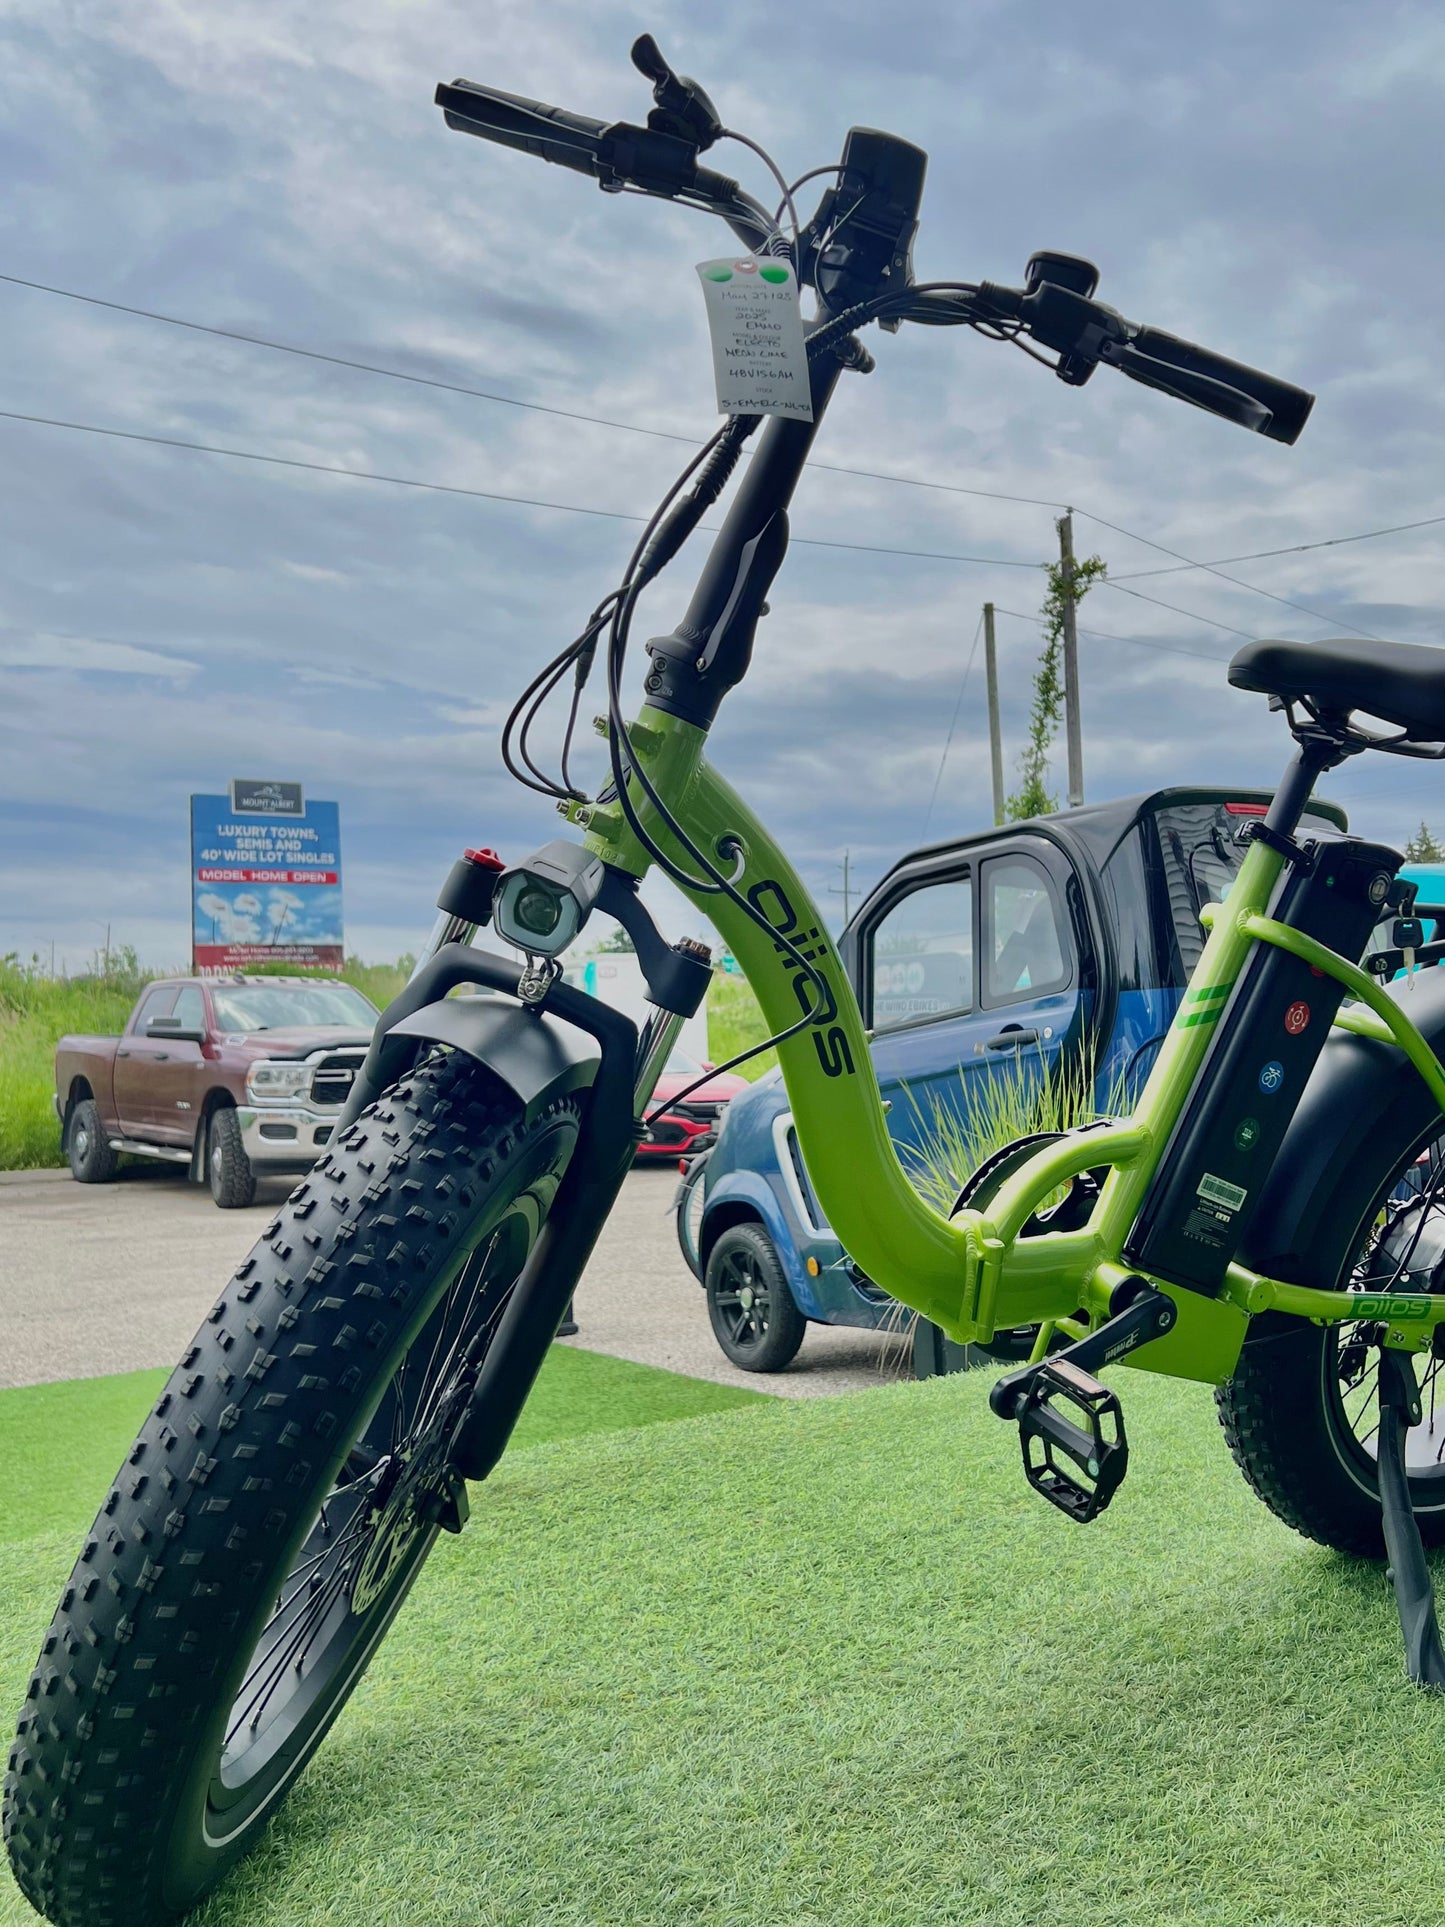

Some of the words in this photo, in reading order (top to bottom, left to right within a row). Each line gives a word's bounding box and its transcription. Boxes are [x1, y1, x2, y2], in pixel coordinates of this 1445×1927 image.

[735, 312, 767, 321] 2025
[242, 797, 270, 807] MOUNT
[217, 825, 267, 837] LUXURY
[270, 827, 319, 841] TOWNS,
[236, 837, 273, 849] SEMIS
[275, 839, 302, 850] AND
[201, 849, 222, 861] 40'
[223, 850, 258, 862] WIDE
[259, 851, 285, 863] LOT
[285, 852, 335, 865] SINGLES
[202, 870, 247, 881] MODEL
[251, 871, 289, 882] HOME
[292, 872, 327, 882] OPEN
